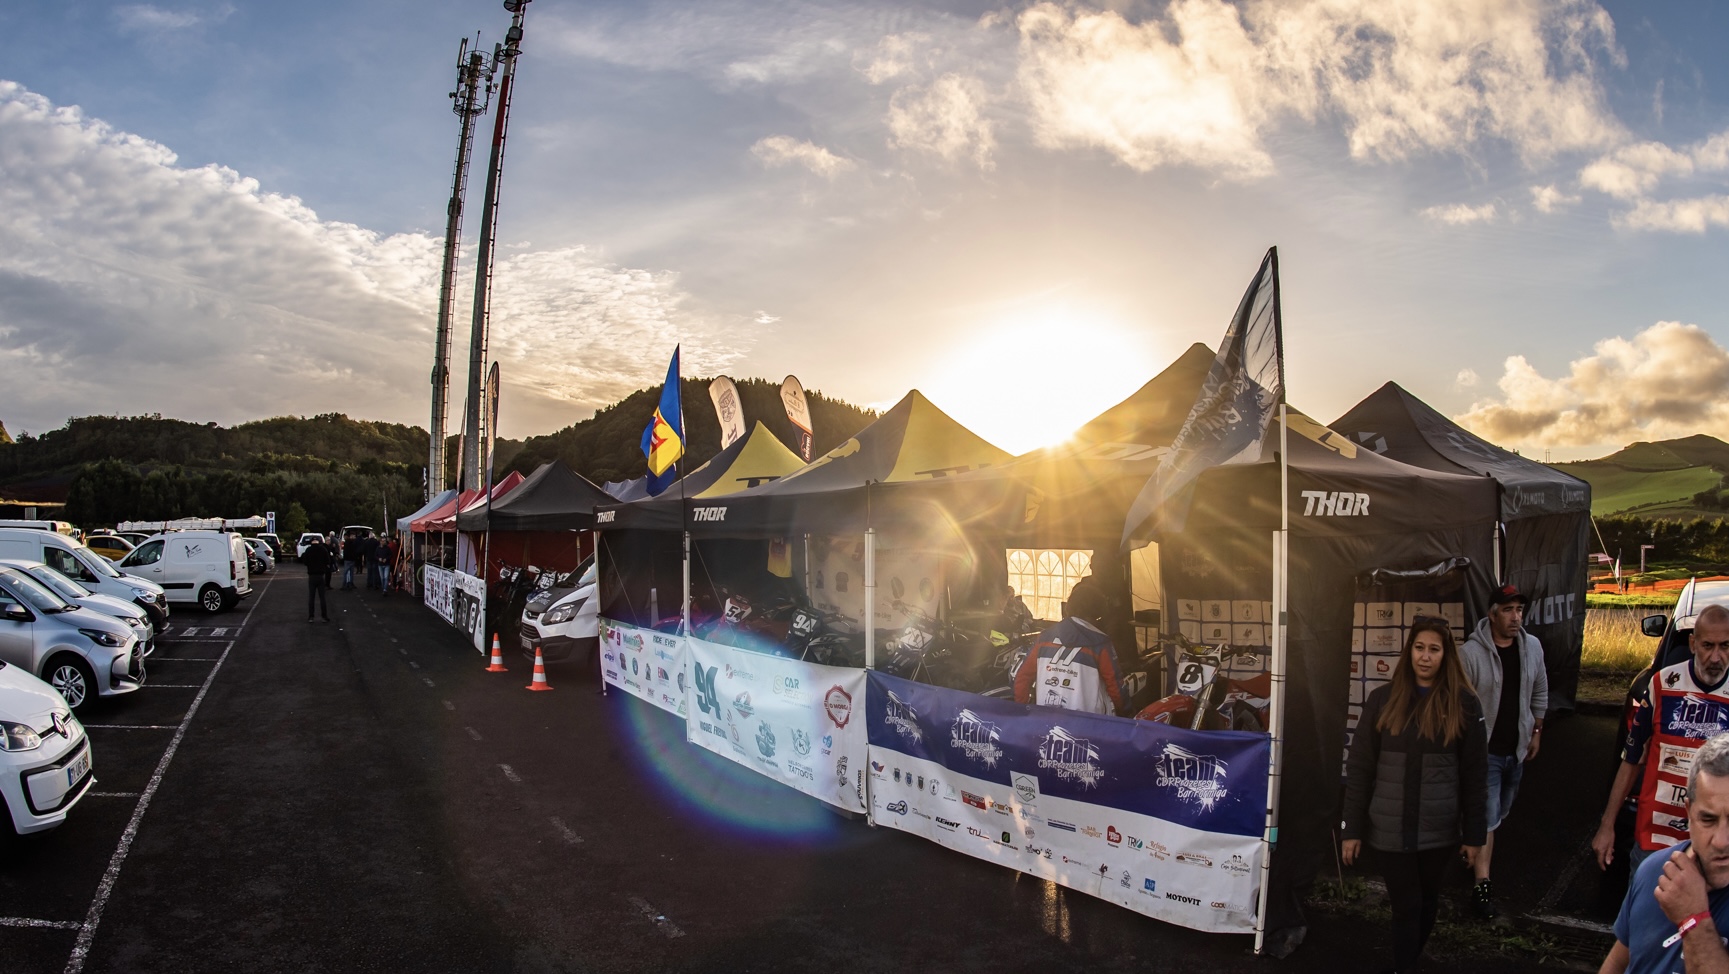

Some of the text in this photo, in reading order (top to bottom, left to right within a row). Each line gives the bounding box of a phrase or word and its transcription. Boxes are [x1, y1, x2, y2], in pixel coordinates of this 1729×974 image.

[1301, 490, 1370, 516] THOR
[597, 510, 615, 523] THOR
[693, 507, 727, 521] THOR
[726, 606, 746, 621] 54
[1525, 593, 1575, 626] MOTO
[793, 614, 817, 633] 94
[664, 638, 677, 649] EVER
[784, 676, 800, 690] CAR
[1179, 664, 1204, 685] 8
[694, 661, 722, 721] 94
[1680, 701, 1720, 723] team
[957, 715, 994, 741] team
[1046, 734, 1090, 763] team
[1164, 753, 1217, 780] team
[935, 816, 961, 828] KENNY
[1166, 892, 1202, 907] MOTOVIT
